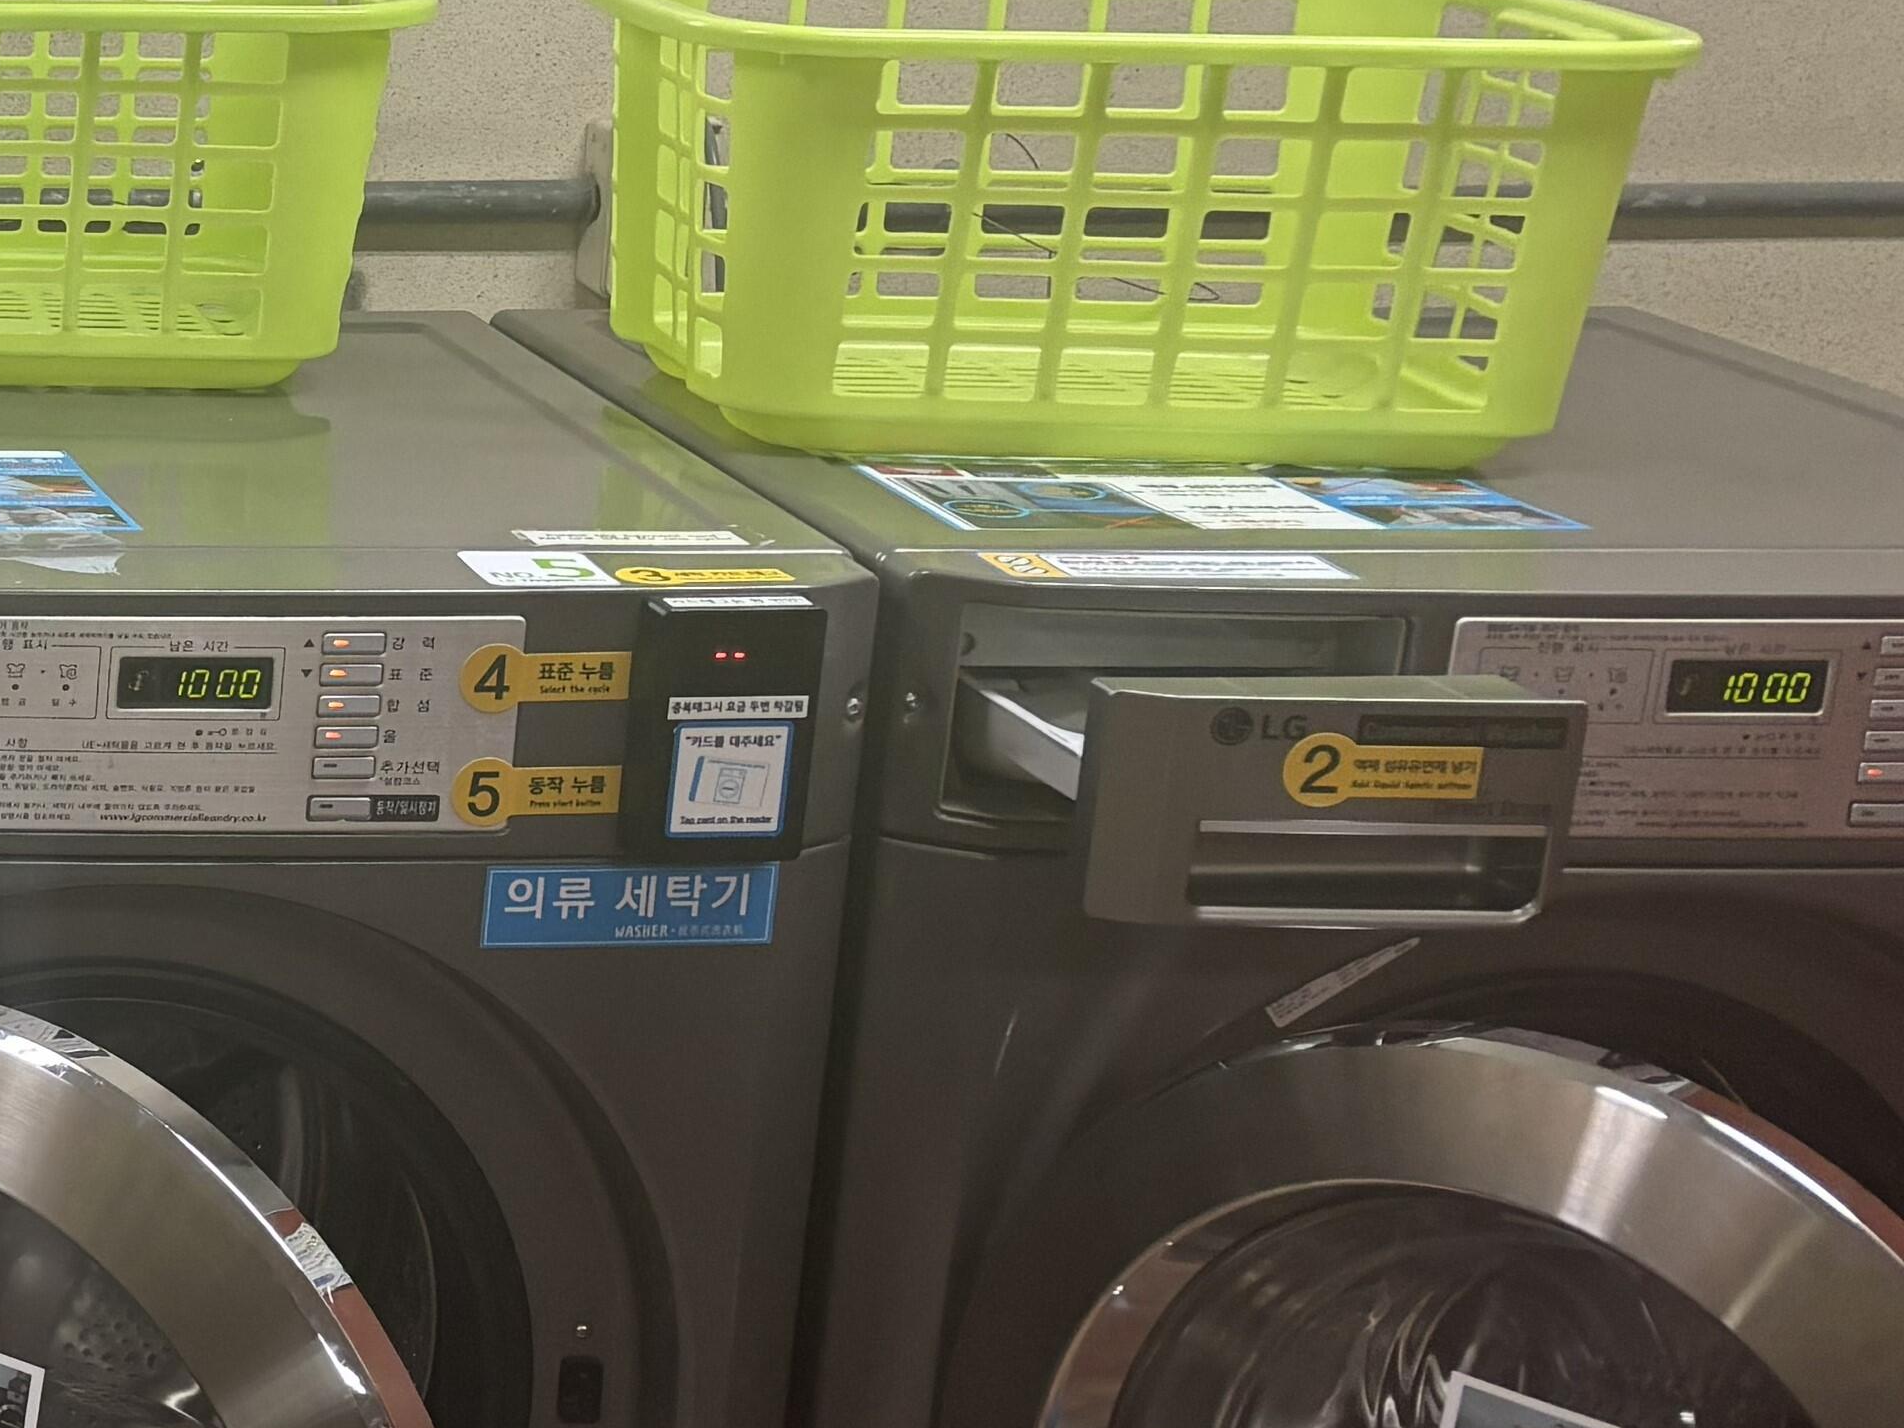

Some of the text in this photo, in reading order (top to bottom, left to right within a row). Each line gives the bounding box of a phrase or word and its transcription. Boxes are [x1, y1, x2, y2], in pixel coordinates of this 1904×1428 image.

[169, 639, 229, 653] 남은 시간
[473, 654, 511, 701] 4
[537, 661, 616, 682] 표준 누름
[528, 775, 607, 796] 동작 누름
[1299, 744, 1341, 794] 2
[467, 770, 500, 818] 5
[503, 873, 750, 920] 의류 세탁기
[615, 924, 668, 938] WASHER
